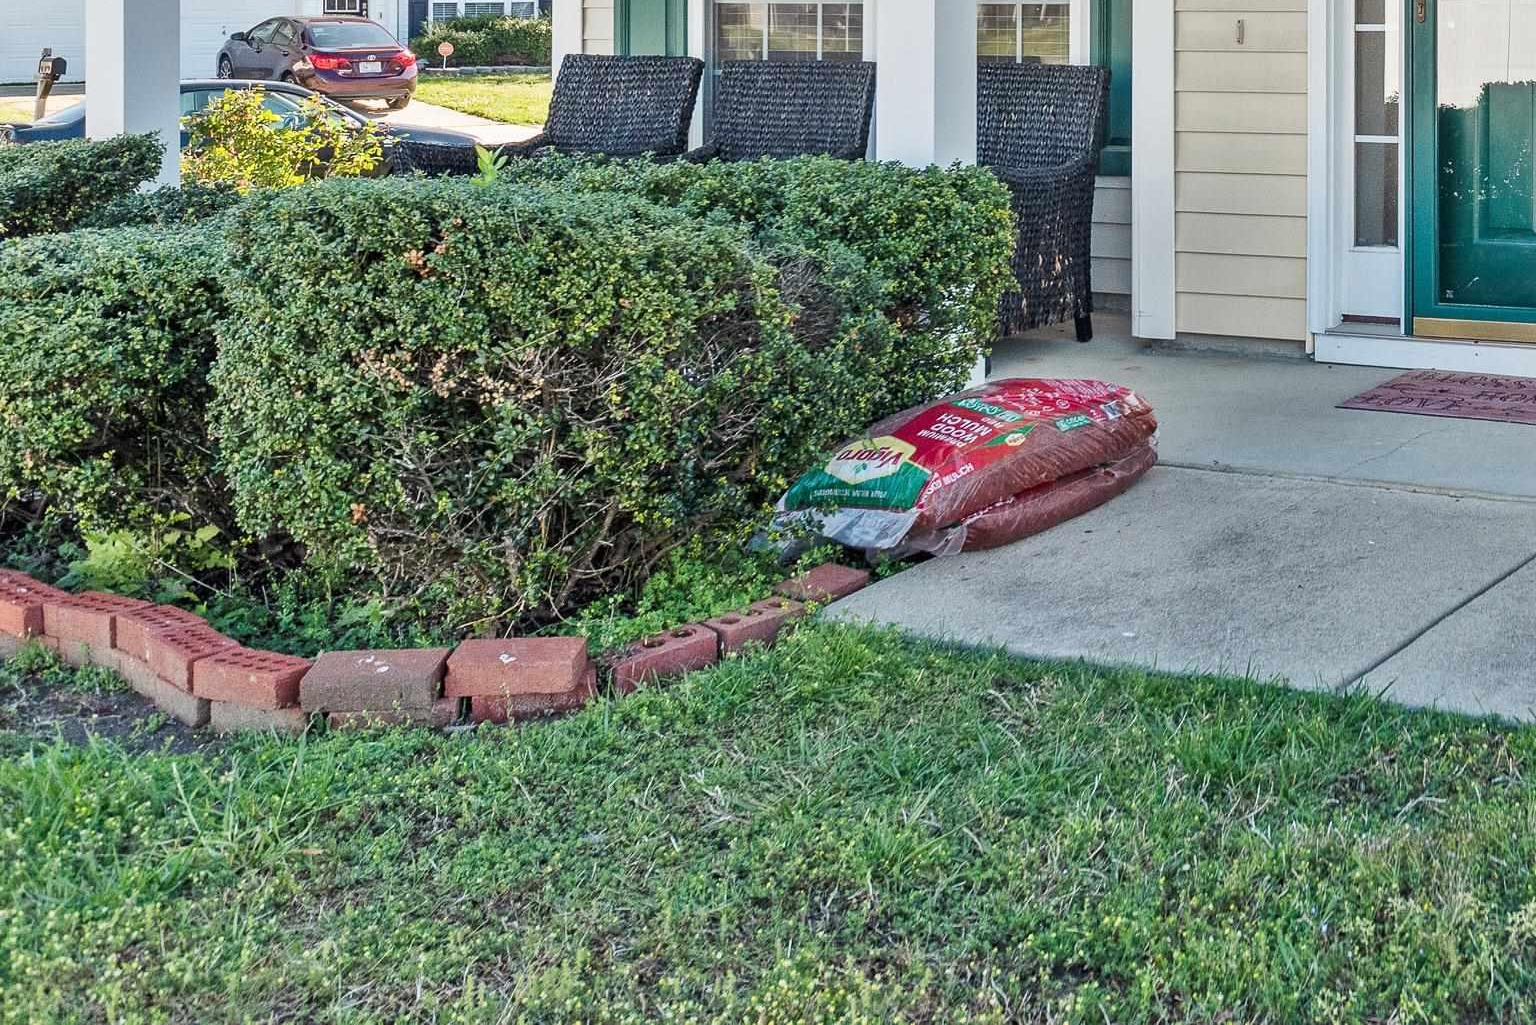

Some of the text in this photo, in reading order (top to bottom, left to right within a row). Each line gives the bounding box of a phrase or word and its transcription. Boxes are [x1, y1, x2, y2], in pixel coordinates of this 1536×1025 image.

[930, 423, 978, 444] WOOD
[936, 412, 992, 436] MULCH
[916, 429, 968, 449] PREMIUM
[837, 446, 903, 469] Vigoro
[942, 462, 975, 485] MULCH
